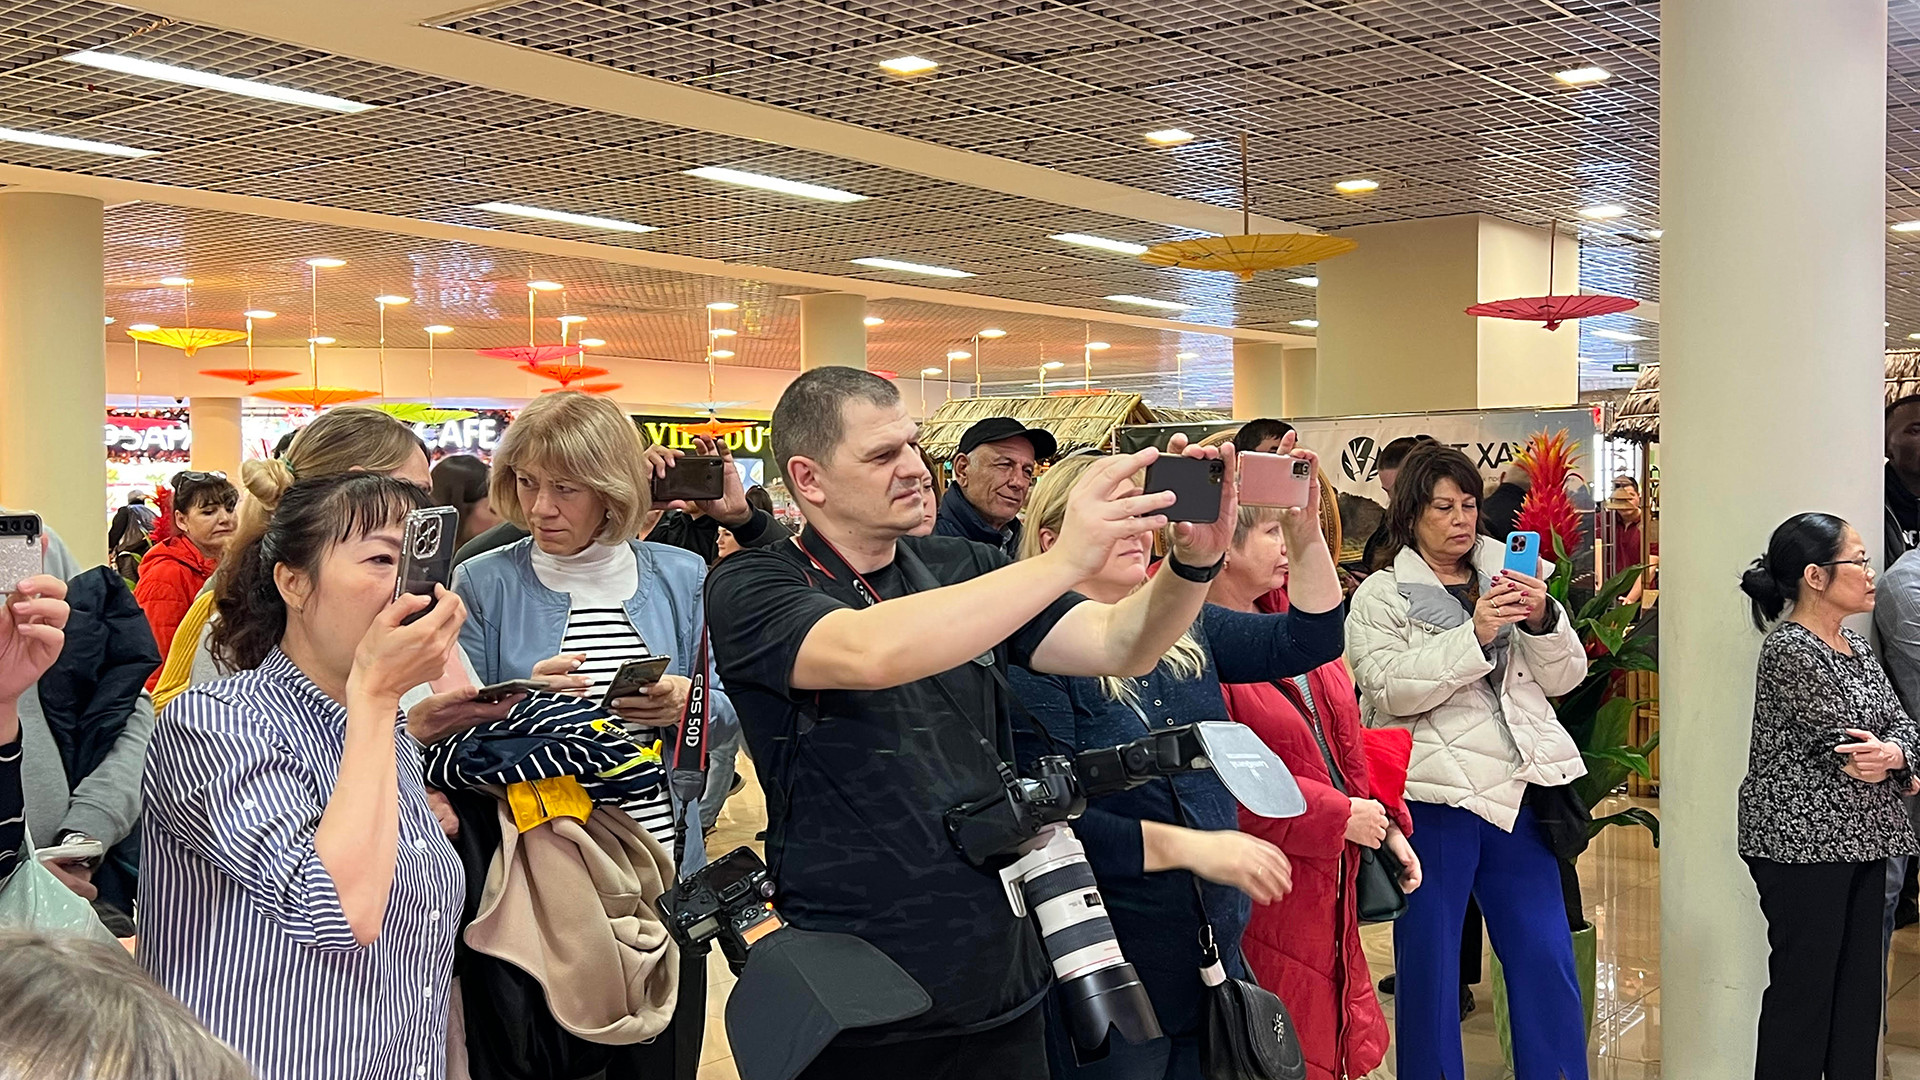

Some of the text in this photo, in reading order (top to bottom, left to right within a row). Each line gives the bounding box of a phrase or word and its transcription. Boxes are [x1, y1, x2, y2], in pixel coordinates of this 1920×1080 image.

[411, 418, 497, 449] CAFE
[685, 673, 704, 747] EOS 50D
